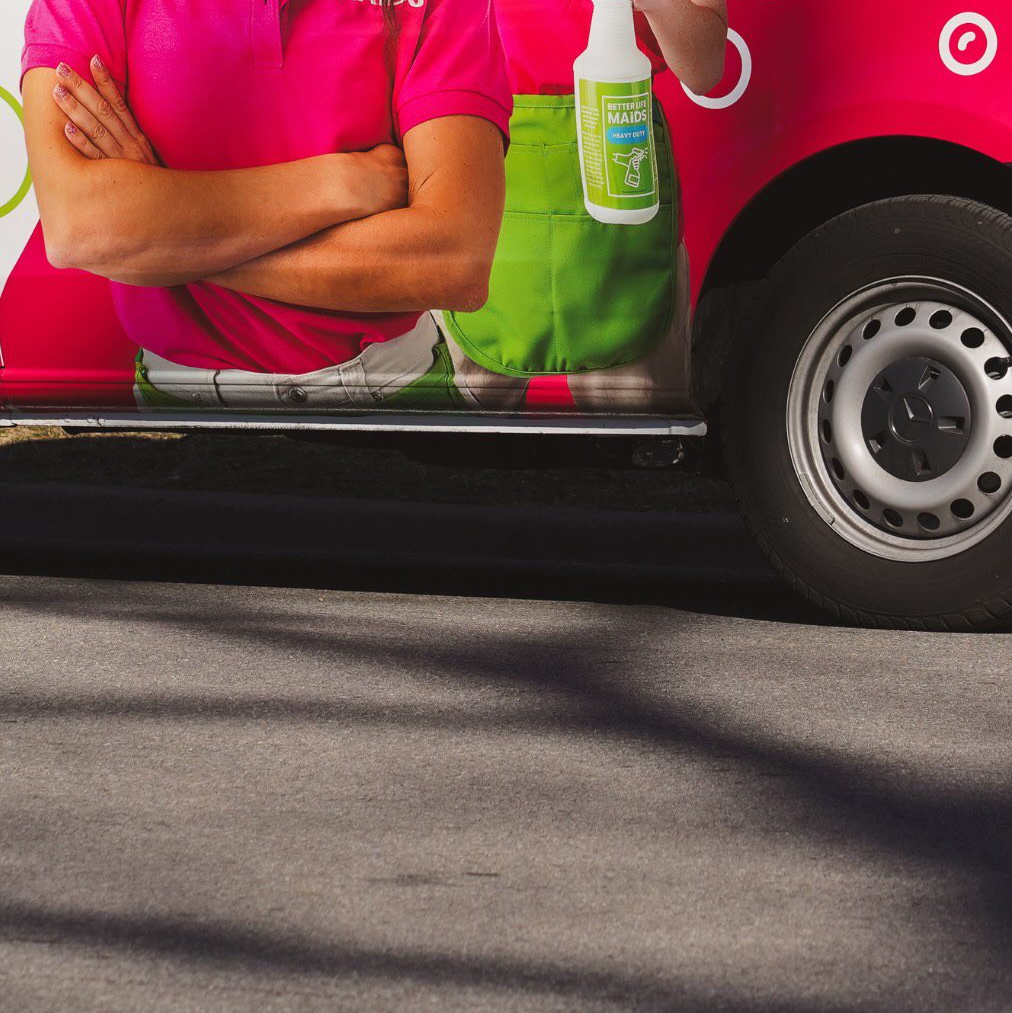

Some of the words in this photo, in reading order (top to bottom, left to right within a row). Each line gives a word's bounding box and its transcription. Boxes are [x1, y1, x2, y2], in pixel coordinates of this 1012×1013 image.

[608, 102, 634, 110] BETTER
[636, 100, 646, 109] LIFE
[608, 110, 646, 124] MAIDS
[633, 130, 645, 138] DUTY
